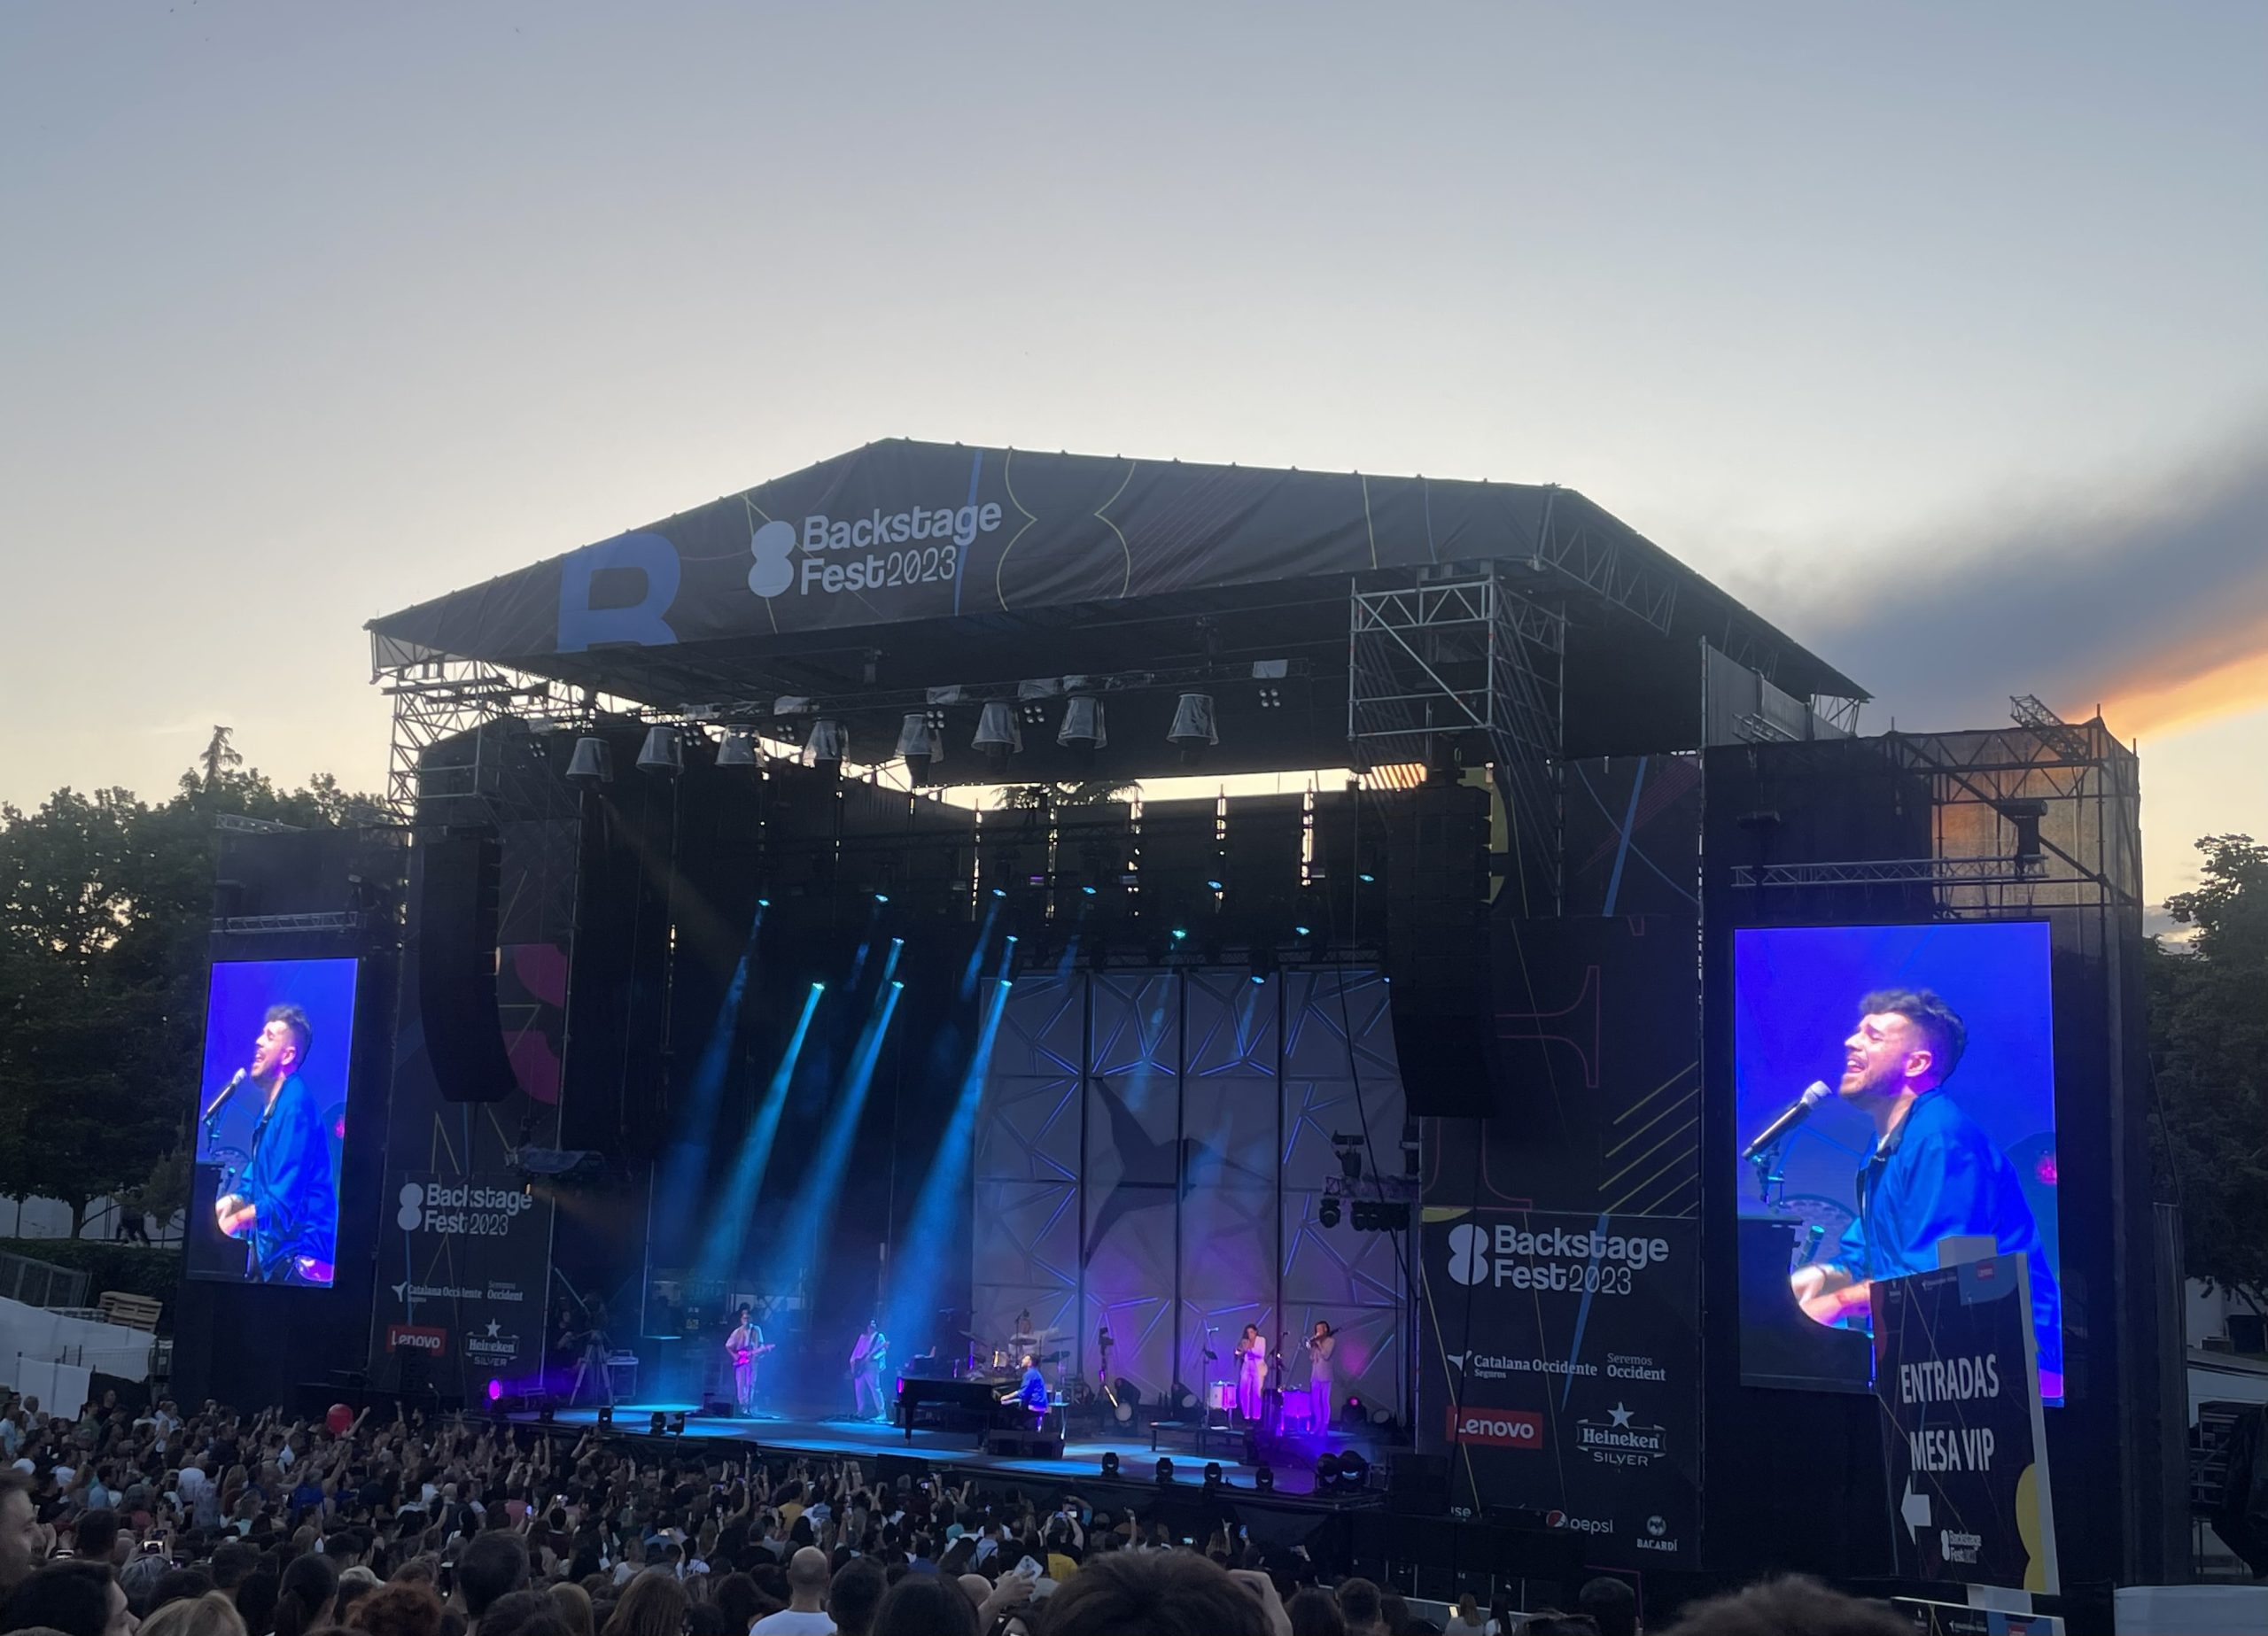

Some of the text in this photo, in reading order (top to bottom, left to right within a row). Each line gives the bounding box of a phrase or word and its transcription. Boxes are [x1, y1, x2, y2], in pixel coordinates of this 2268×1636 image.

[803, 500, 1002, 552] Backstage
[1494, 1225, 1669, 1269] Backstage
[391, 1330, 440, 1348] Lenovo
[1473, 1354, 1598, 1376] Catalana Occidente
[1606, 1353, 1653, 1366] Seremos
[1606, 1364, 1666, 1382] Occident
[1900, 1353, 2000, 1404] ENTRADAS
[1454, 1414, 1534, 1439] Lenovo
[1582, 1427, 1659, 1450] Heineken
[1909, 1428, 1994, 1471] MESA VIP
[1593, 1451, 1649, 1467] SILVER
